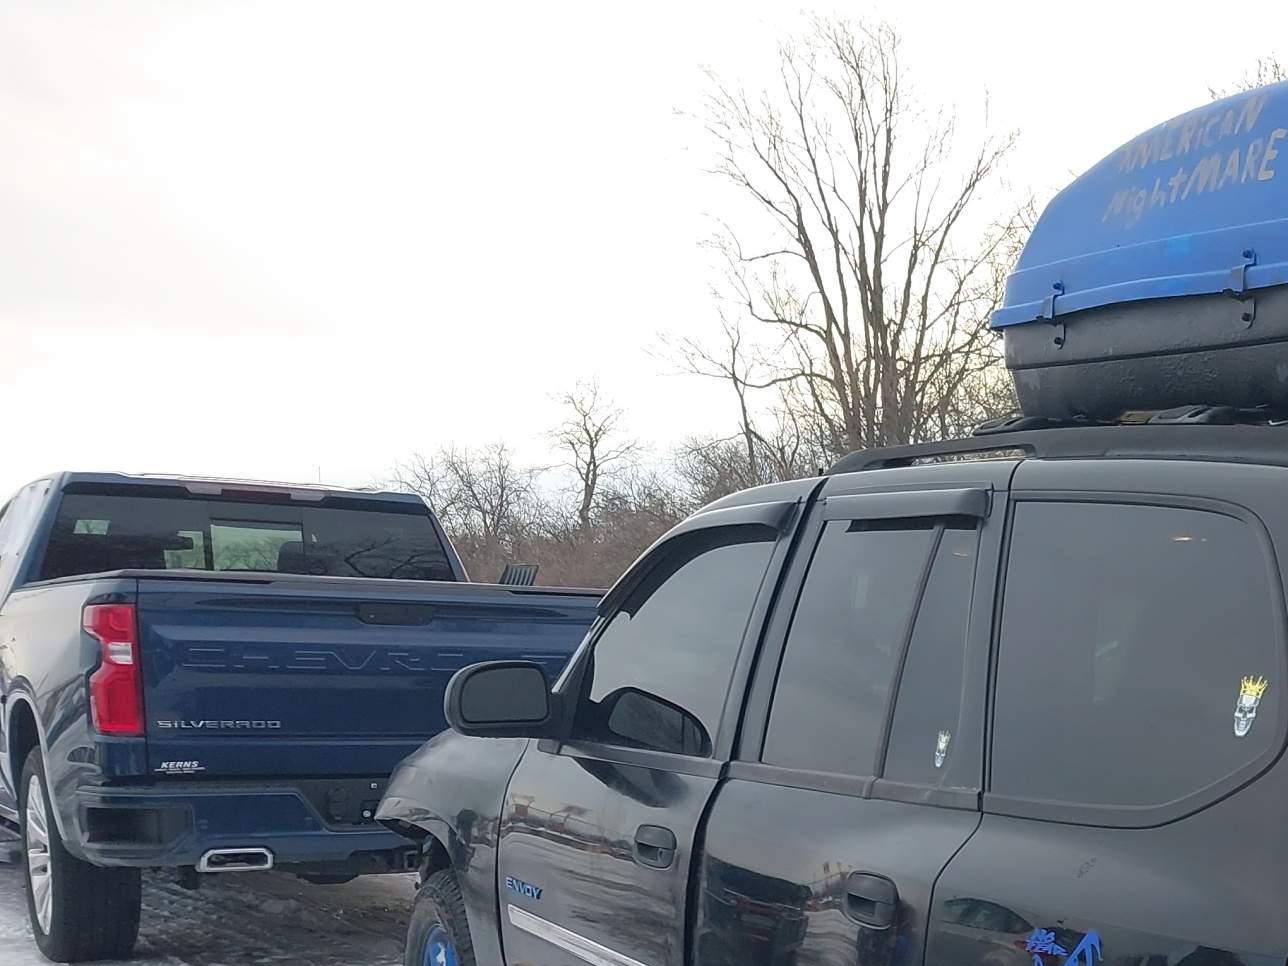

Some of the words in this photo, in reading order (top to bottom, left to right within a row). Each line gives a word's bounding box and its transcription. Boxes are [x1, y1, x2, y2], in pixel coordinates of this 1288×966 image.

[157, 720, 281, 729] SILVERADO
[161, 760, 199, 769] KERNS
[505, 876, 543, 900] ENVOY
